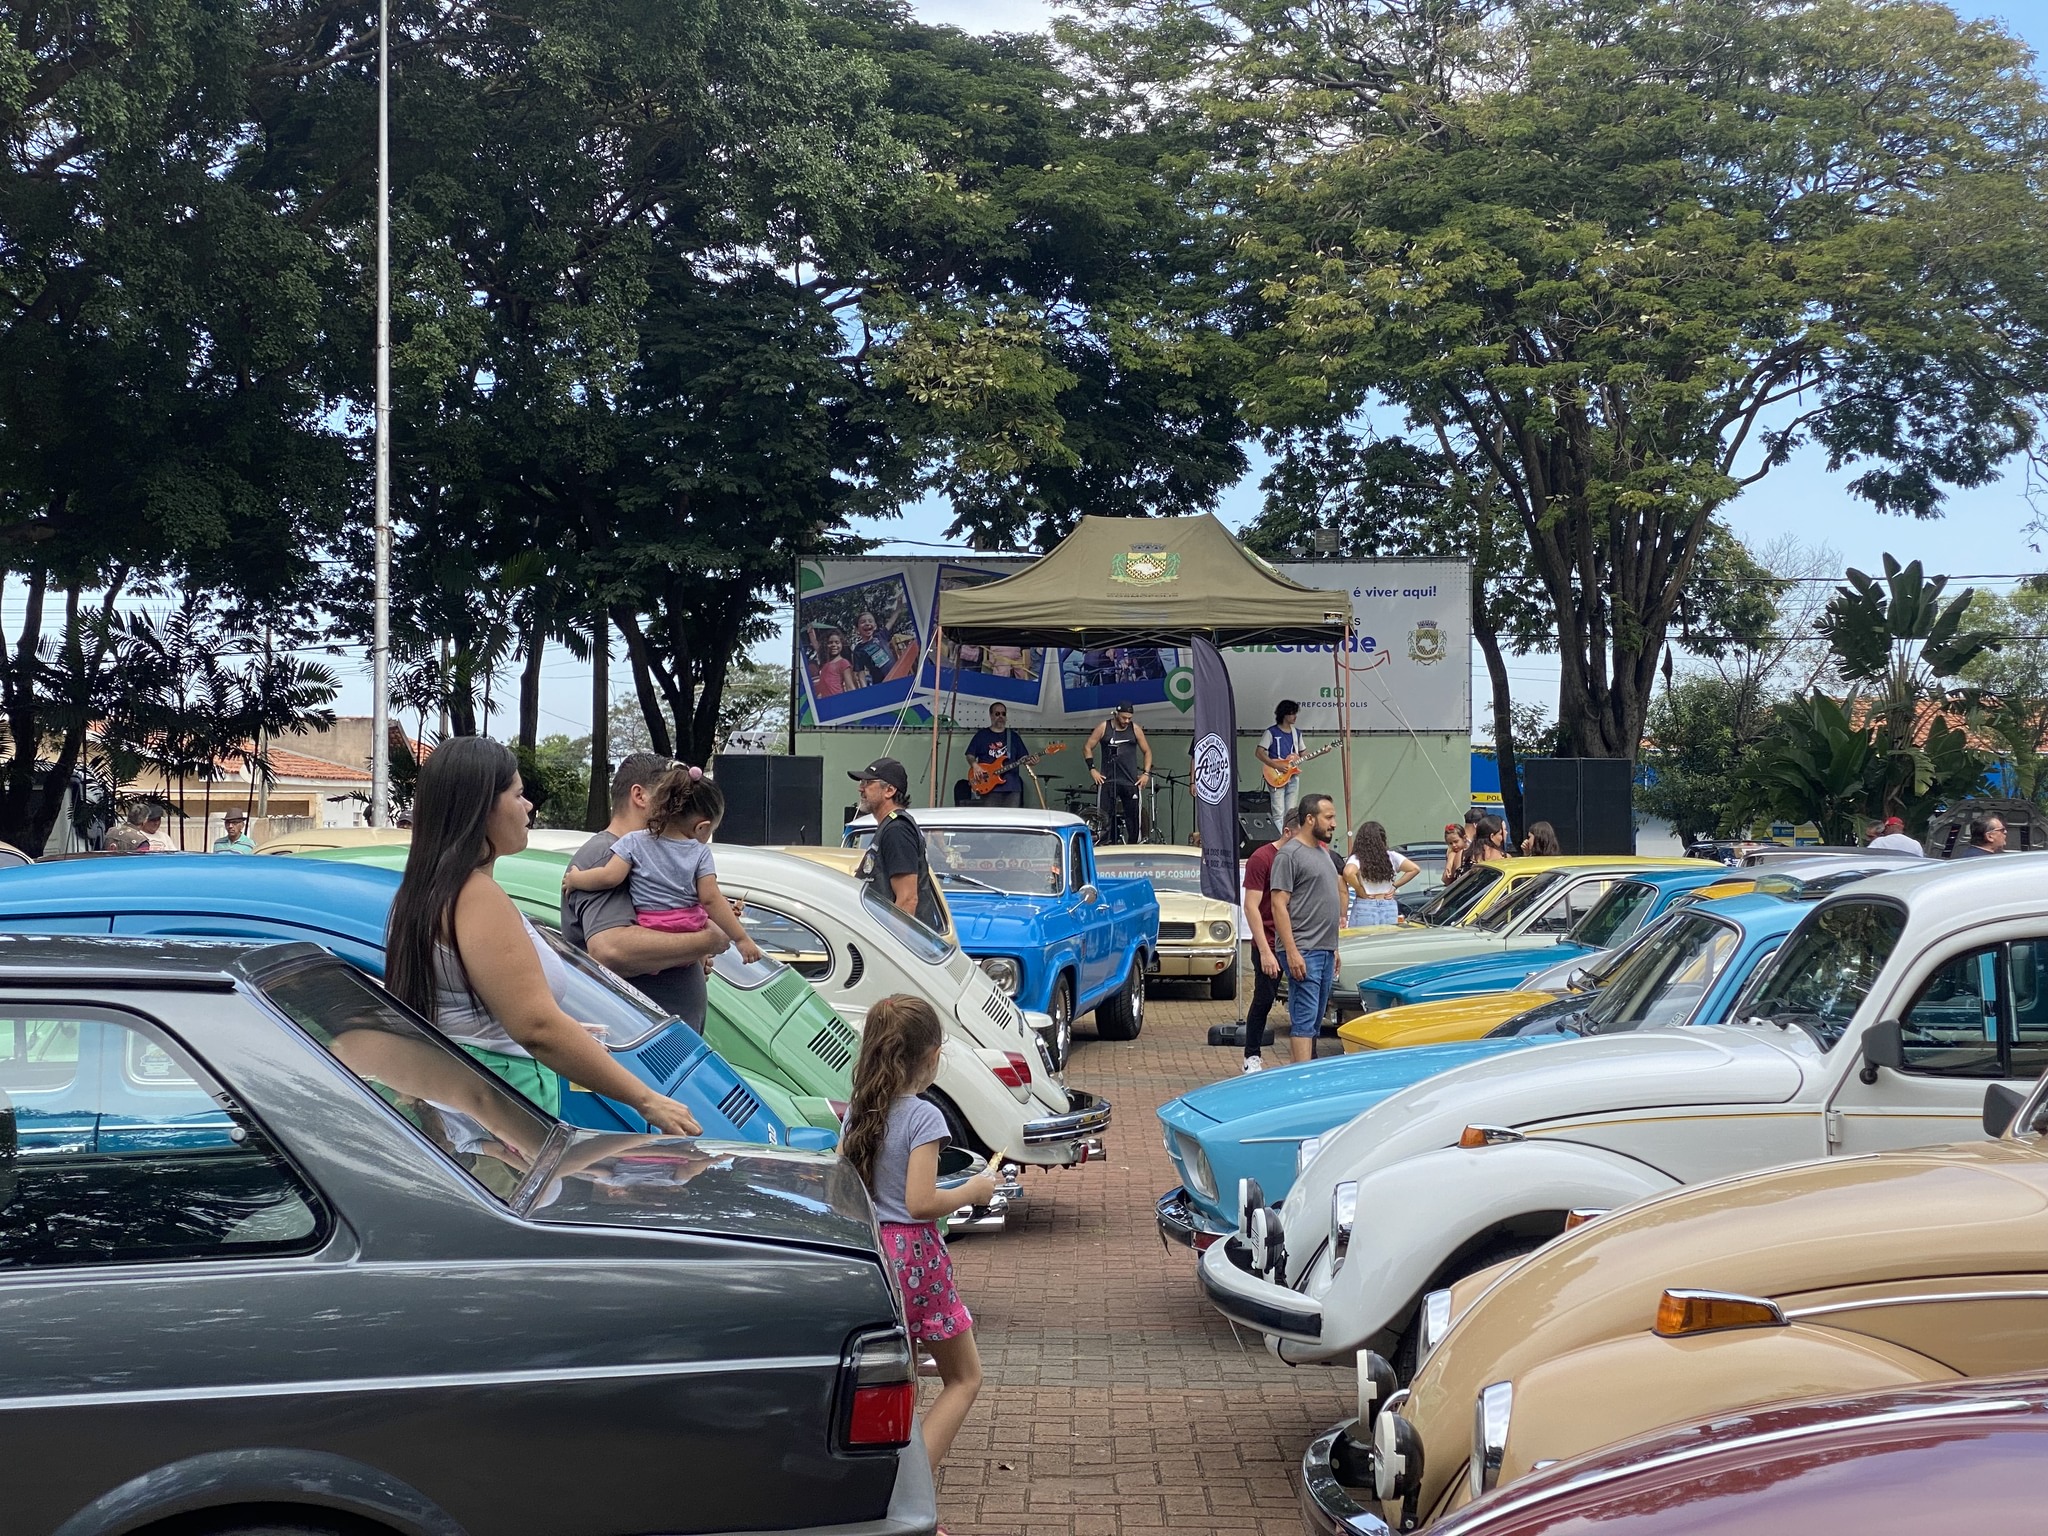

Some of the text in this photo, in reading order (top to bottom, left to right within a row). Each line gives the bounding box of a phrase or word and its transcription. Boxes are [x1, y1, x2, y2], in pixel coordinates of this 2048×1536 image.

[1353, 586, 1437, 599] é viver aqui!
[1119, 871, 1153, 879] ANTIGOS
[1155, 870, 1167, 879] DE
